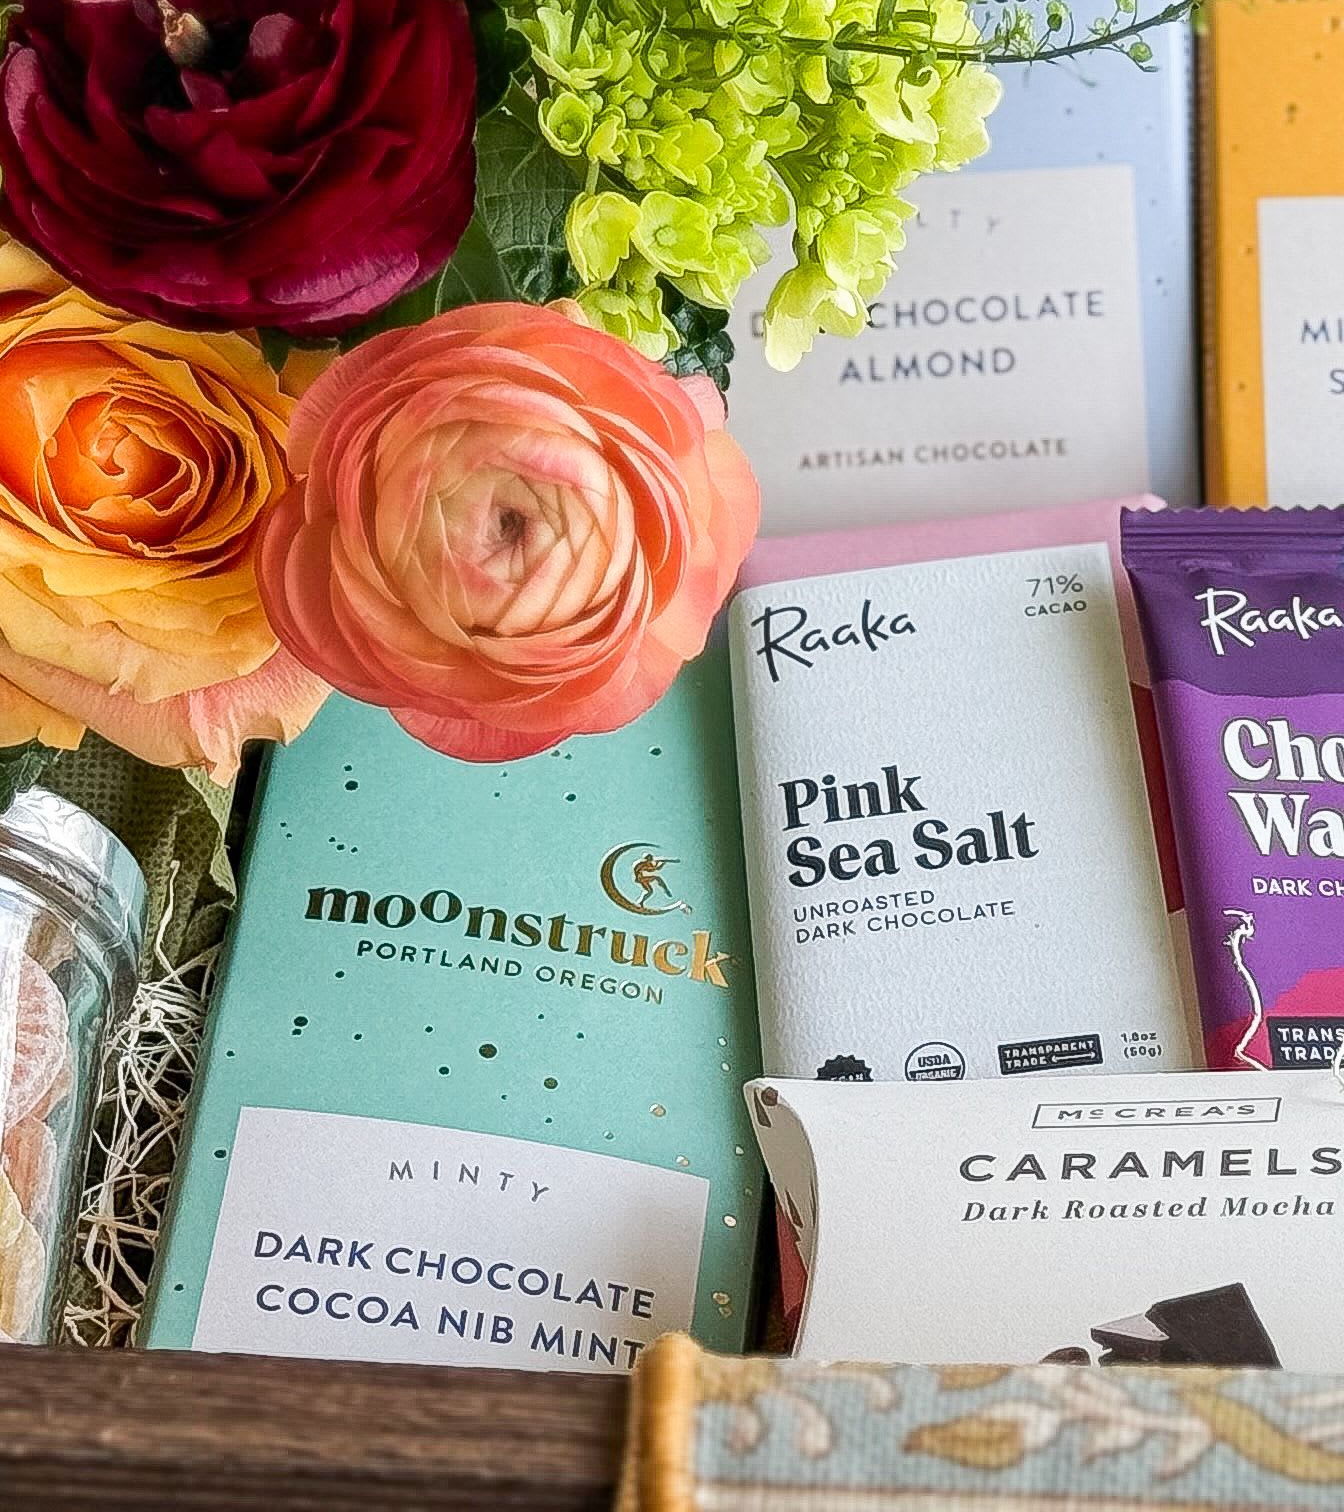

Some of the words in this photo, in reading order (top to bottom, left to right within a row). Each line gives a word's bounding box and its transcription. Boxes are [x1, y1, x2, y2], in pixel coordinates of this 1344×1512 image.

[867, 290, 1106, 329] CHOCOLATE
[839, 347, 1016, 384] ALMOND
[799, 447, 904, 471] ARTISAN
[914, 438, 1067, 465] CHOCOLATE
[1025, 573, 1084, 598] 71%
[1024, 599, 1088, 617] CACAO
[1194, 588, 1344, 655] Raaka
[751, 599, 917, 682] Raaka
[778, 765, 928, 831] Pink
[786, 836, 900, 888] Sea
[912, 810, 1040, 870] Salt
[793, 889, 935, 923] UNROASTED
[1252, 877, 1313, 897] DARK
[303, 885, 731, 988] moonstruck
[796, 922, 857, 944] DARK
[867, 899, 1016, 933] CHOCOLATE
[356, 939, 523, 977] PORTLAND
[535, 965, 664, 1005] OREGON
[917, 1053, 952, 1067] USDA
[1003, 1040, 1095, 1059] TRANSPARENT
[1005, 1056, 1048, 1069] TRADE
[388, 1159, 549, 1203] MINTY
[959, 1146, 1343, 1182] CARAMELS
[962, 1199, 1049, 1222] Dark
[1063, 1196, 1209, 1220] Roasted
[1220, 1195, 1337, 1218] Mocha
[253, 1231, 372, 1271] DARK
[384, 1247, 655, 1319] CHOCOLATE
[255, 1284, 419, 1331] COCOA
[438, 1308, 514, 1344] NIB
[530, 1322, 646, 1370] MINT
